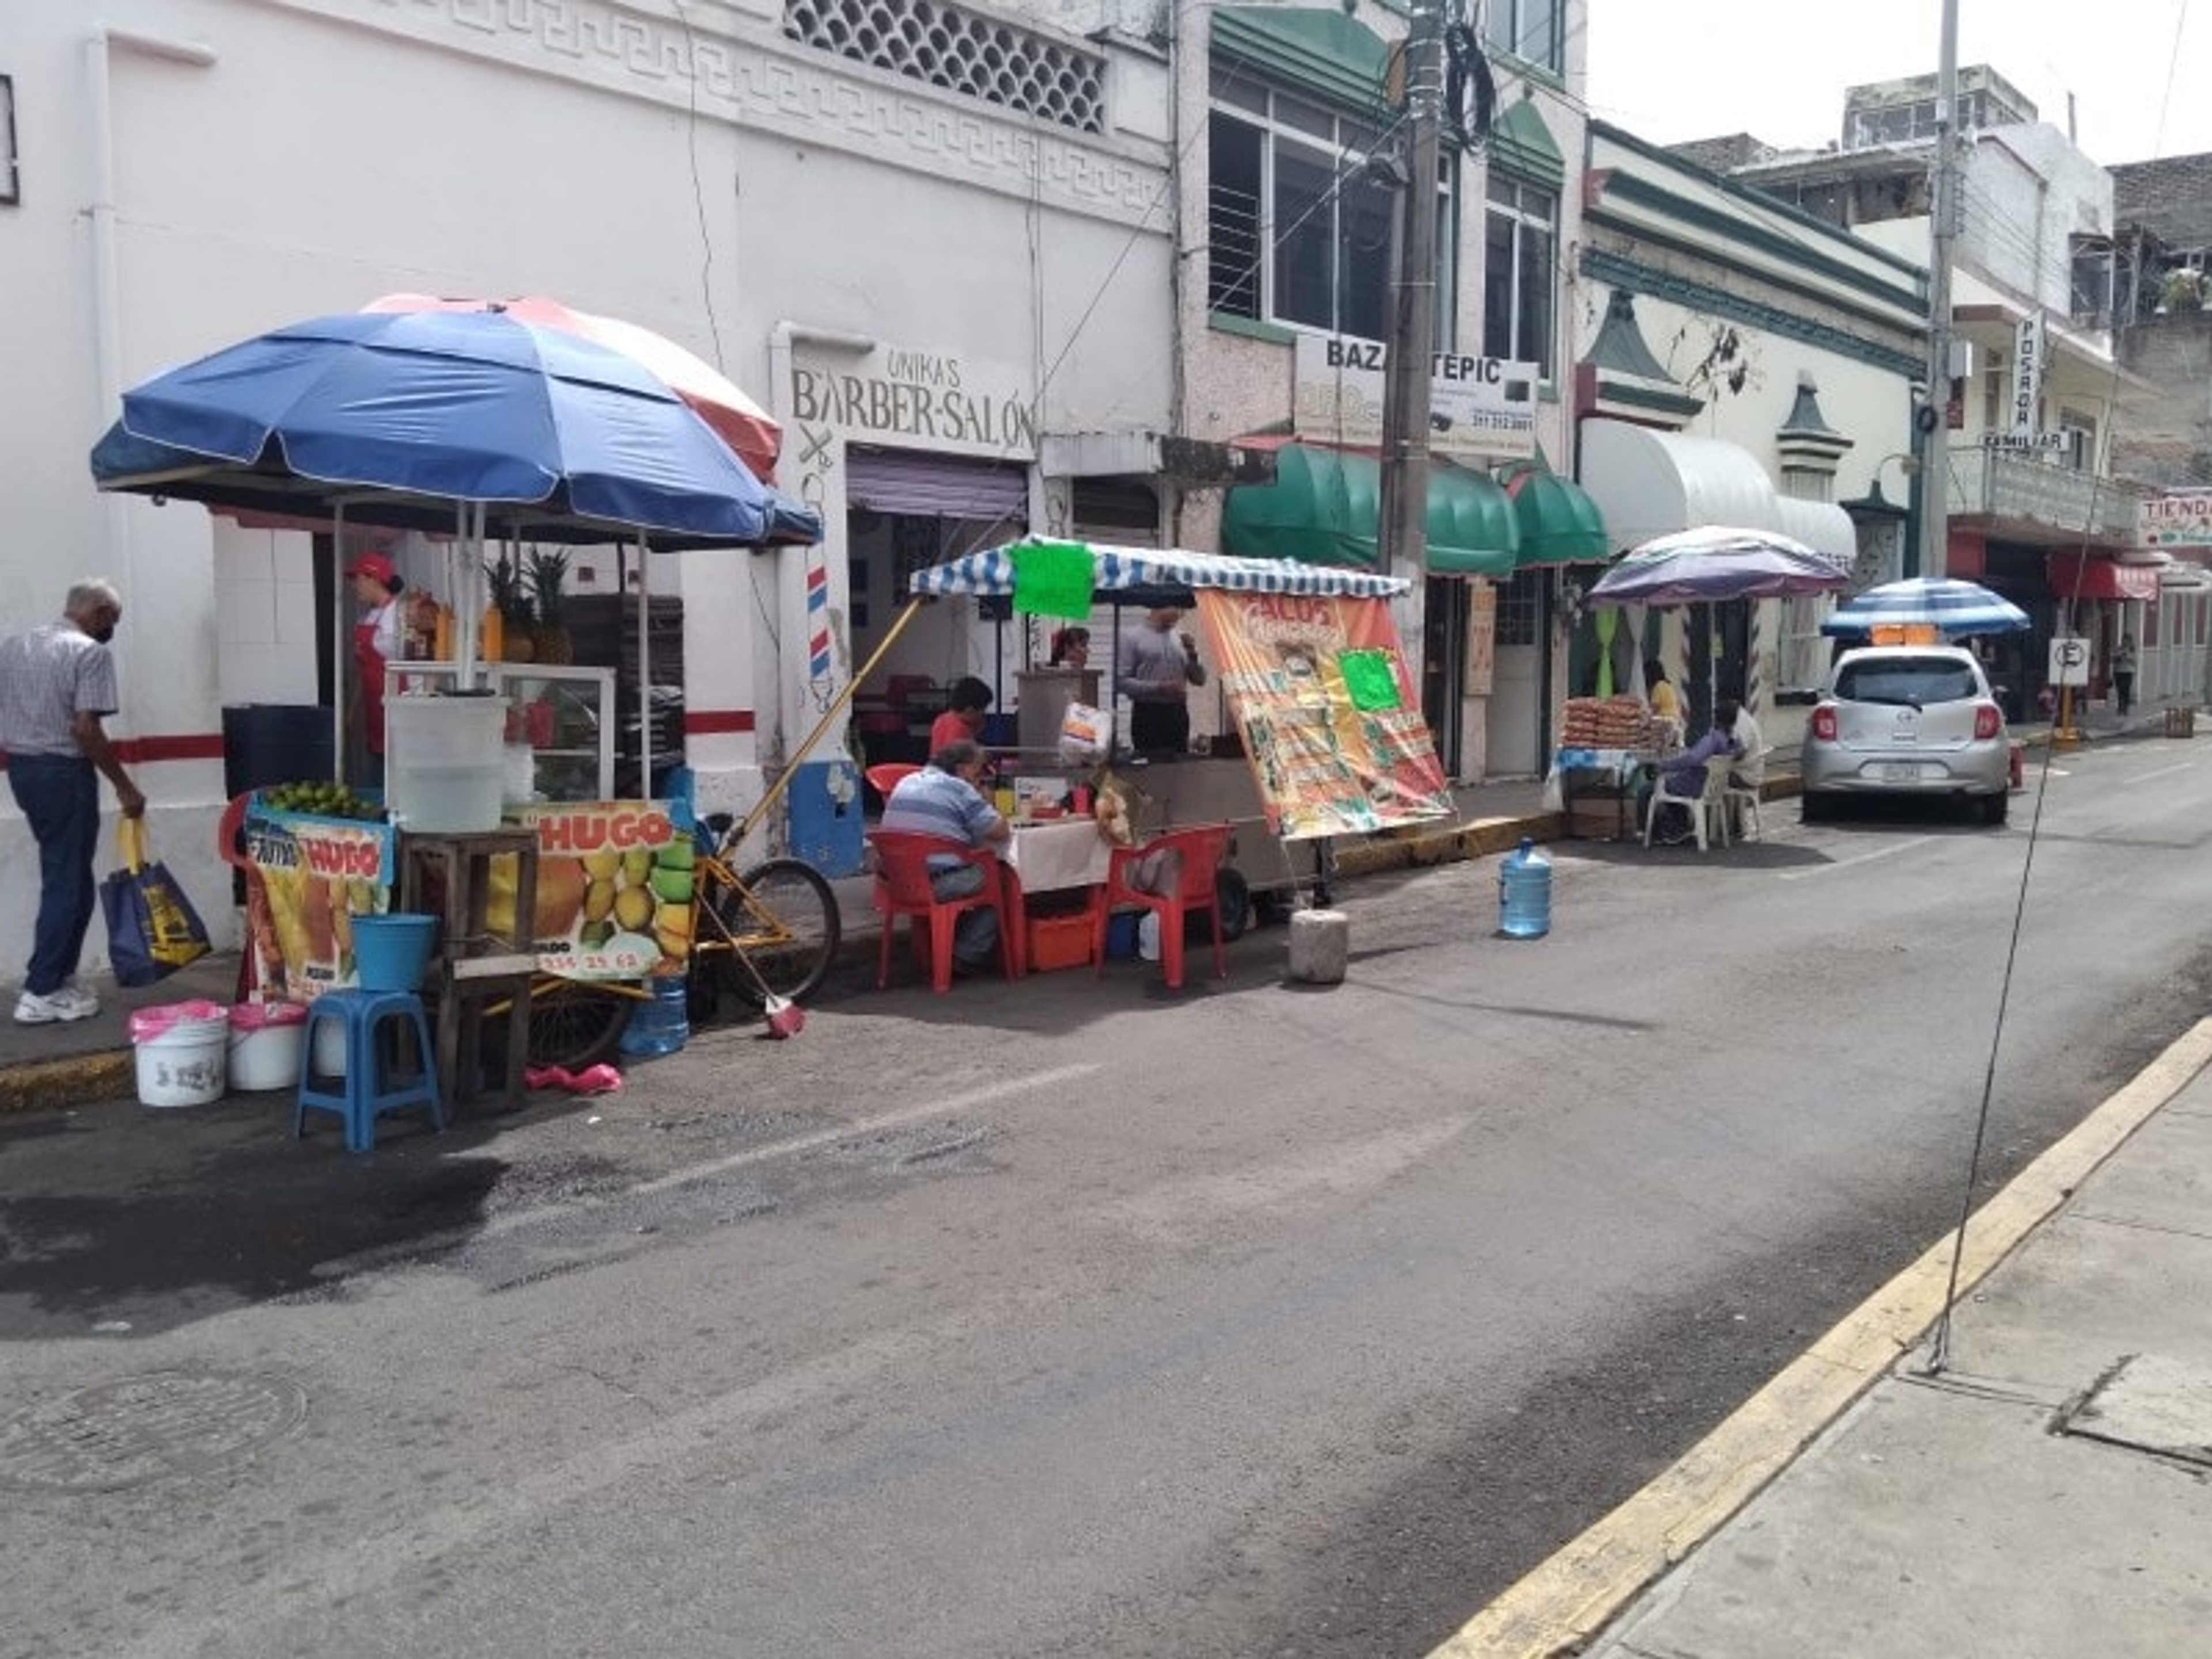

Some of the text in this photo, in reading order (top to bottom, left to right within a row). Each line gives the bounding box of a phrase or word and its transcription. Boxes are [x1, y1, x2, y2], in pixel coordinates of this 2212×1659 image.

[1327, 339, 1501, 385] BAZ TEPIC
[538, 812, 673, 850] HUGO
[306, 838, 380, 878] HUGO
